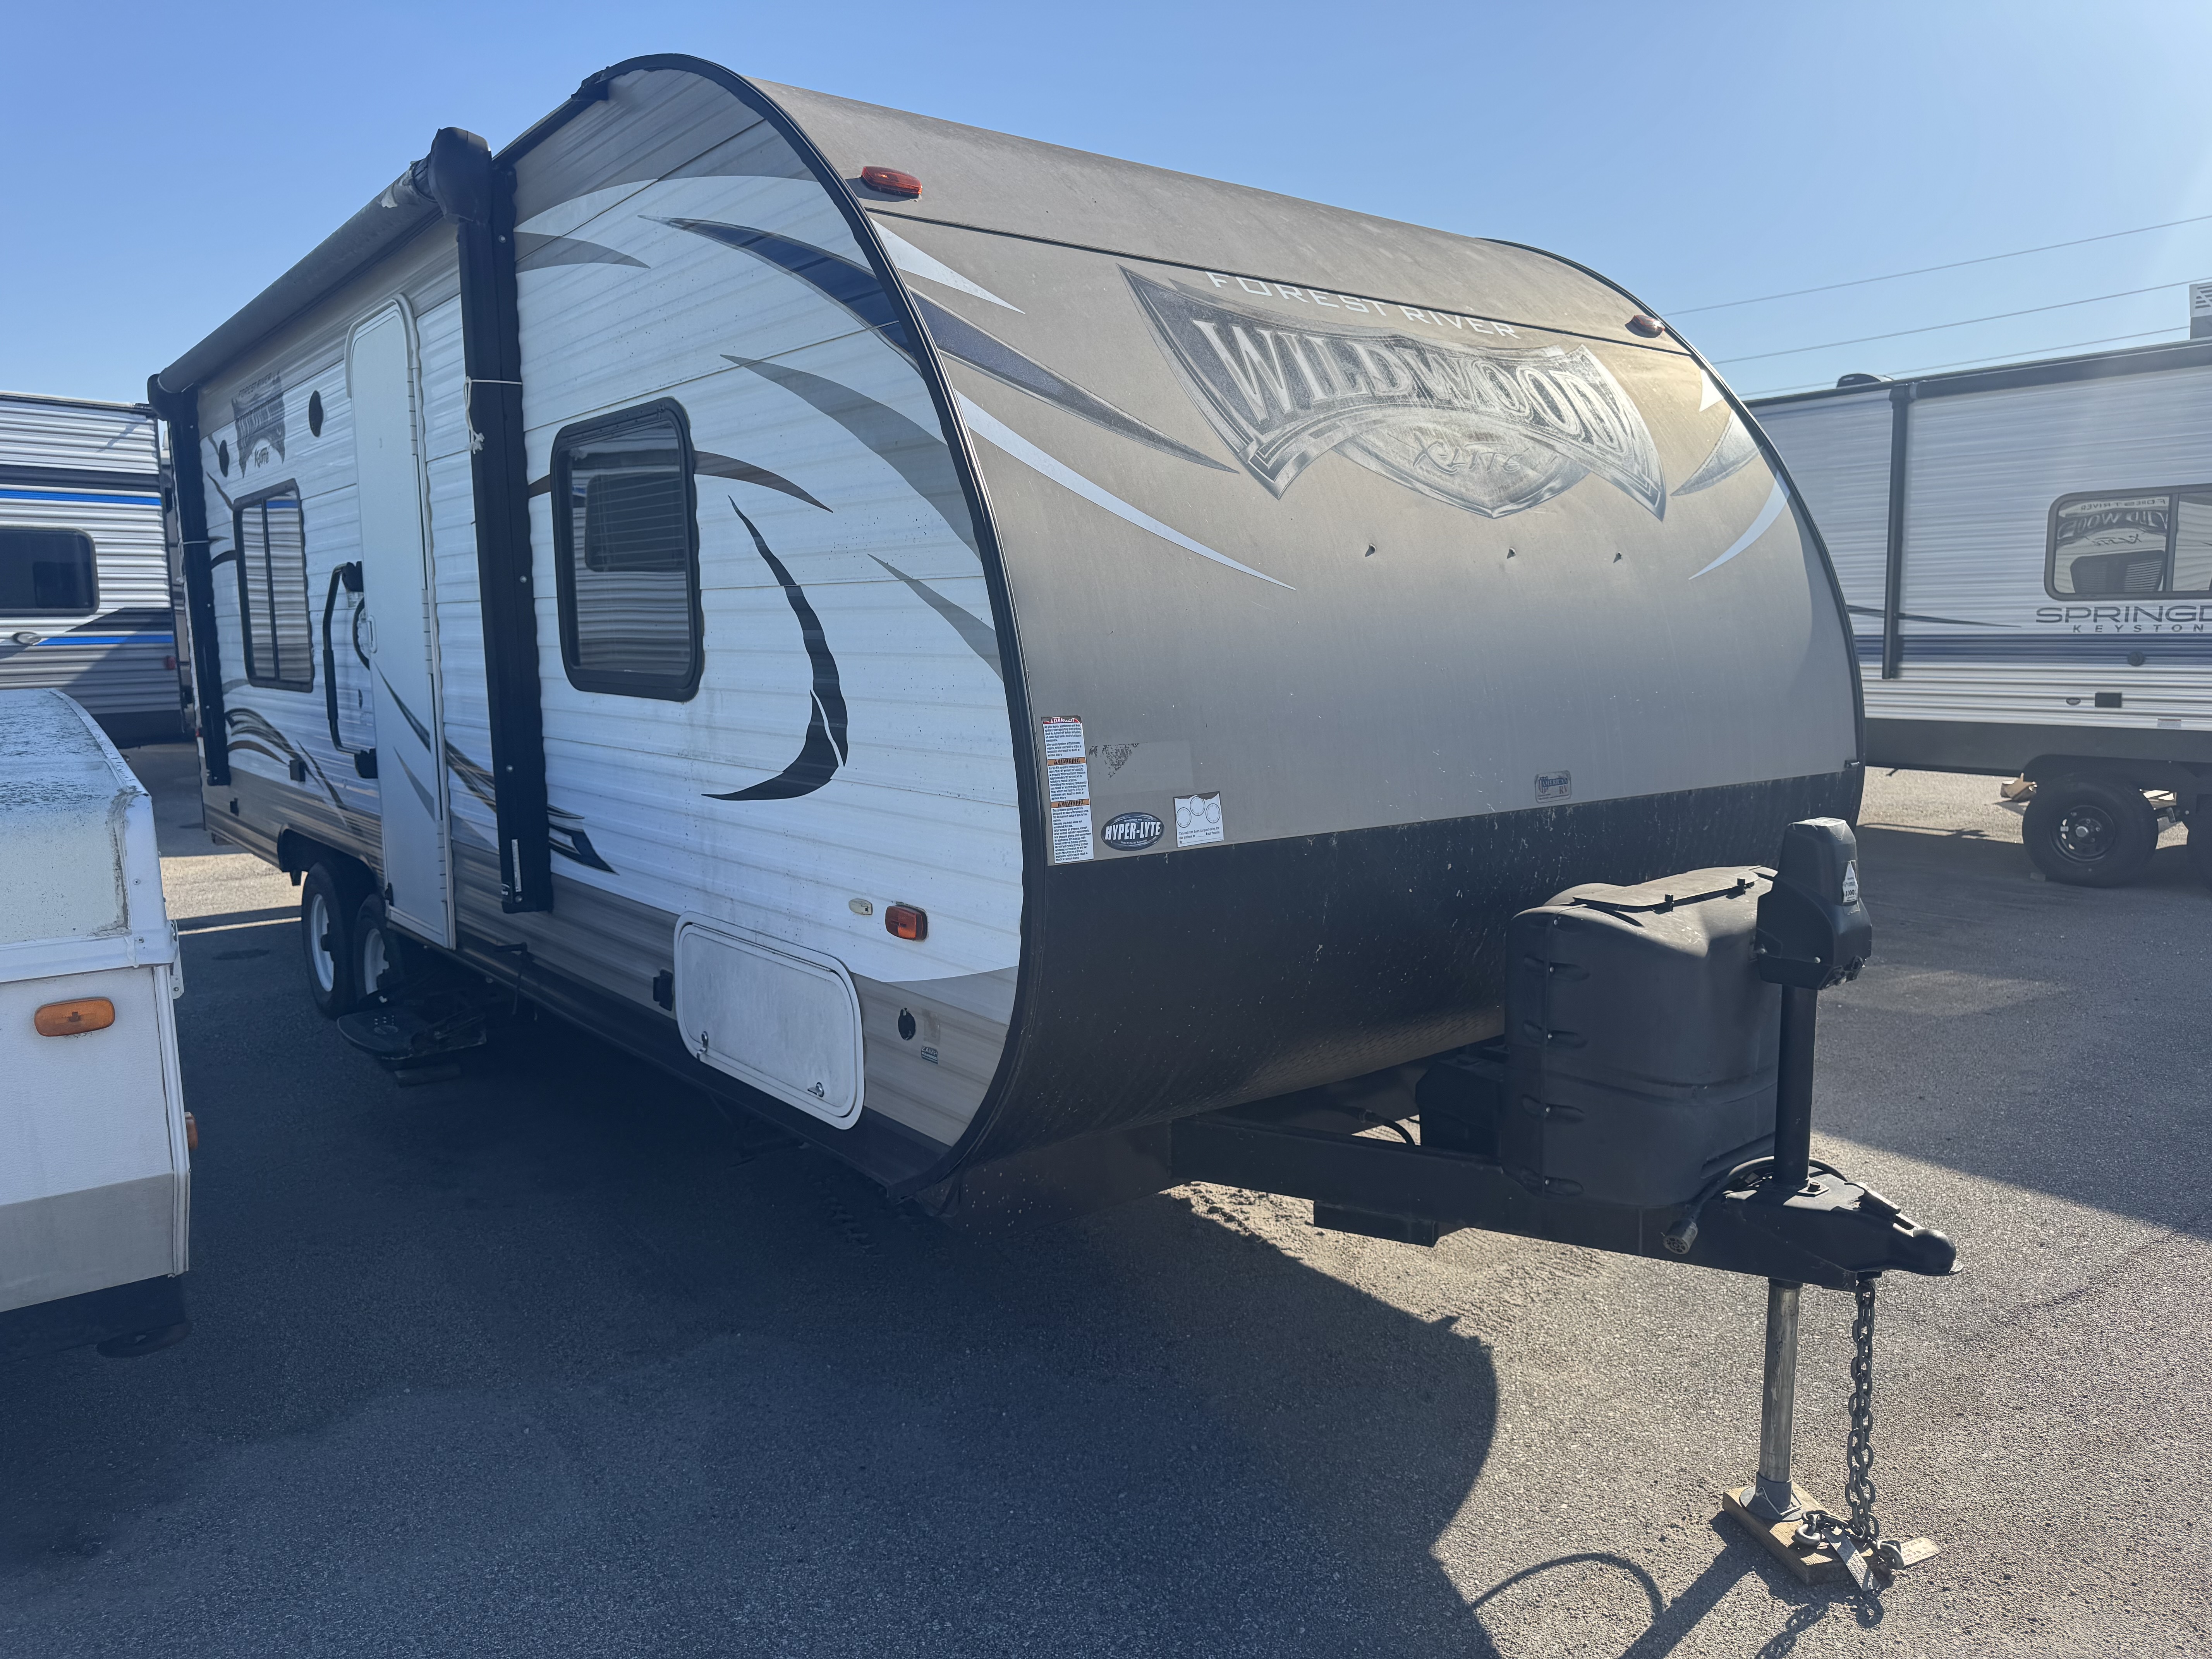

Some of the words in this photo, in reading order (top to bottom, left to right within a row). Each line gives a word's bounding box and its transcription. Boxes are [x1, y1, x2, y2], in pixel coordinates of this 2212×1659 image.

[1206, 271, 1387, 316] FOREST
[1400, 304, 1521, 340] RIVER
[1194, 319, 1622, 450] WILDWOOD
[2073, 624, 2204, 633] KEYSTON
[1559, 785, 1568, 794] RV
[1105, 821, 1161, 840] HYPER-LYTE
